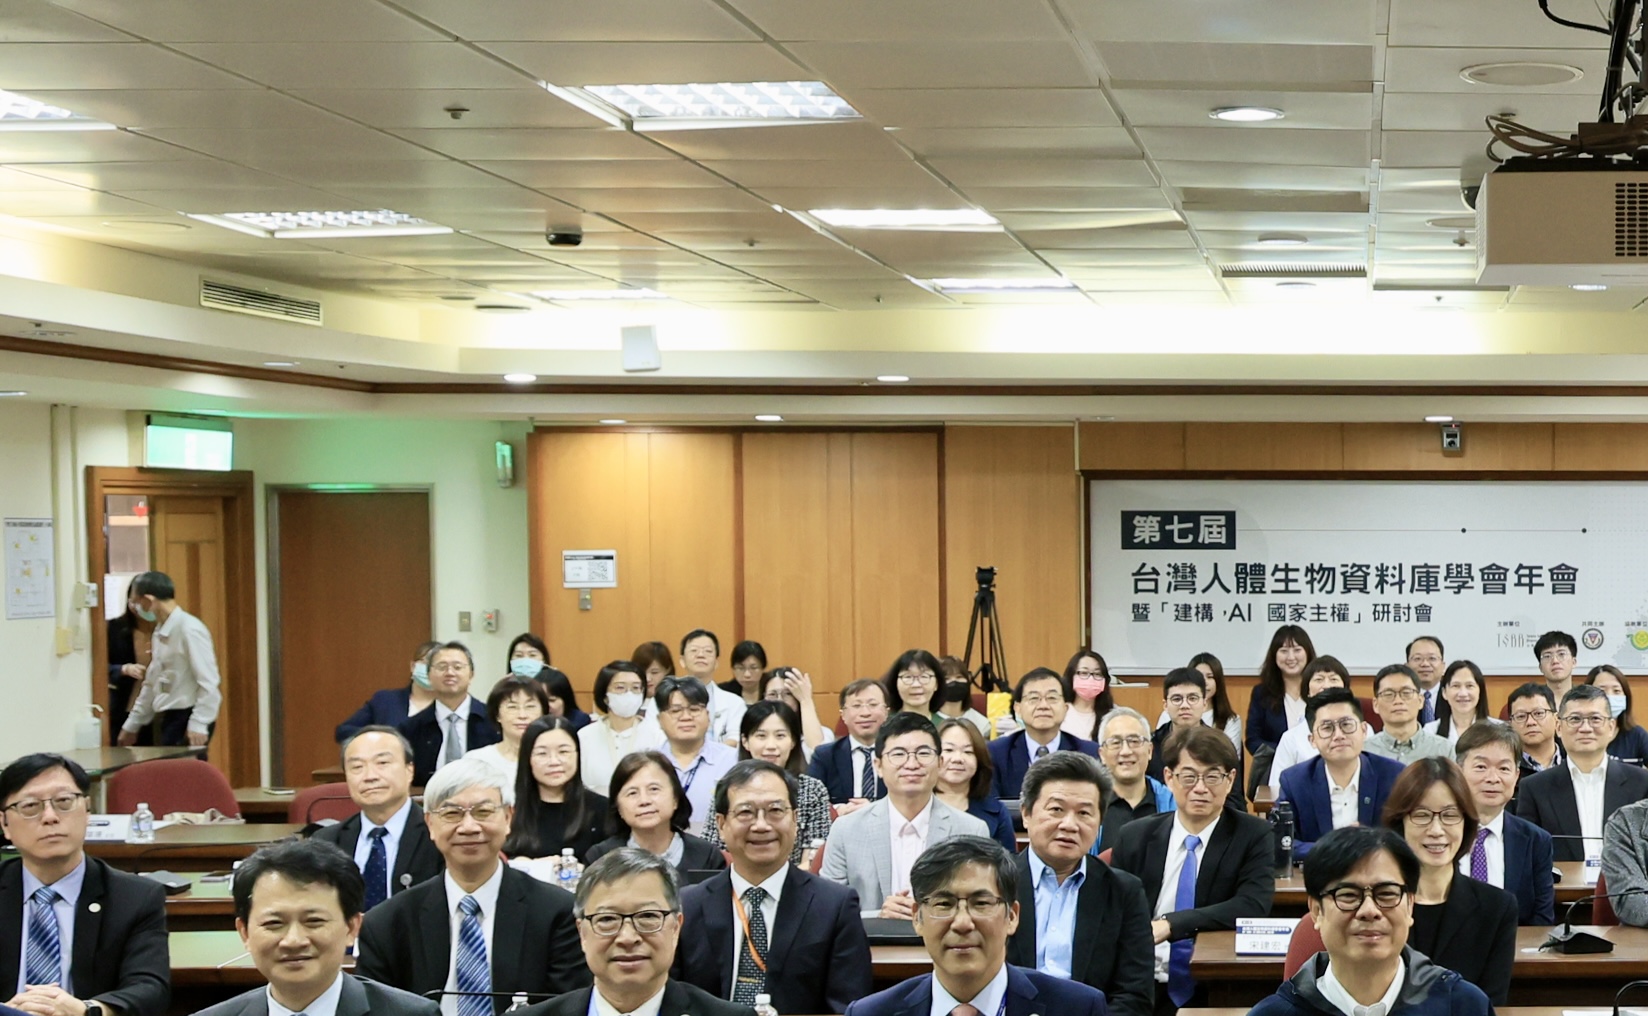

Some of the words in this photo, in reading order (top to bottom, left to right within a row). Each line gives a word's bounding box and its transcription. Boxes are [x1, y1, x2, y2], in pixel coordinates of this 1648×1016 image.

[1132, 514, 1228, 545] 第七屆
[1131, 562, 1580, 596] 台灣人體生物資料庫學會年會
